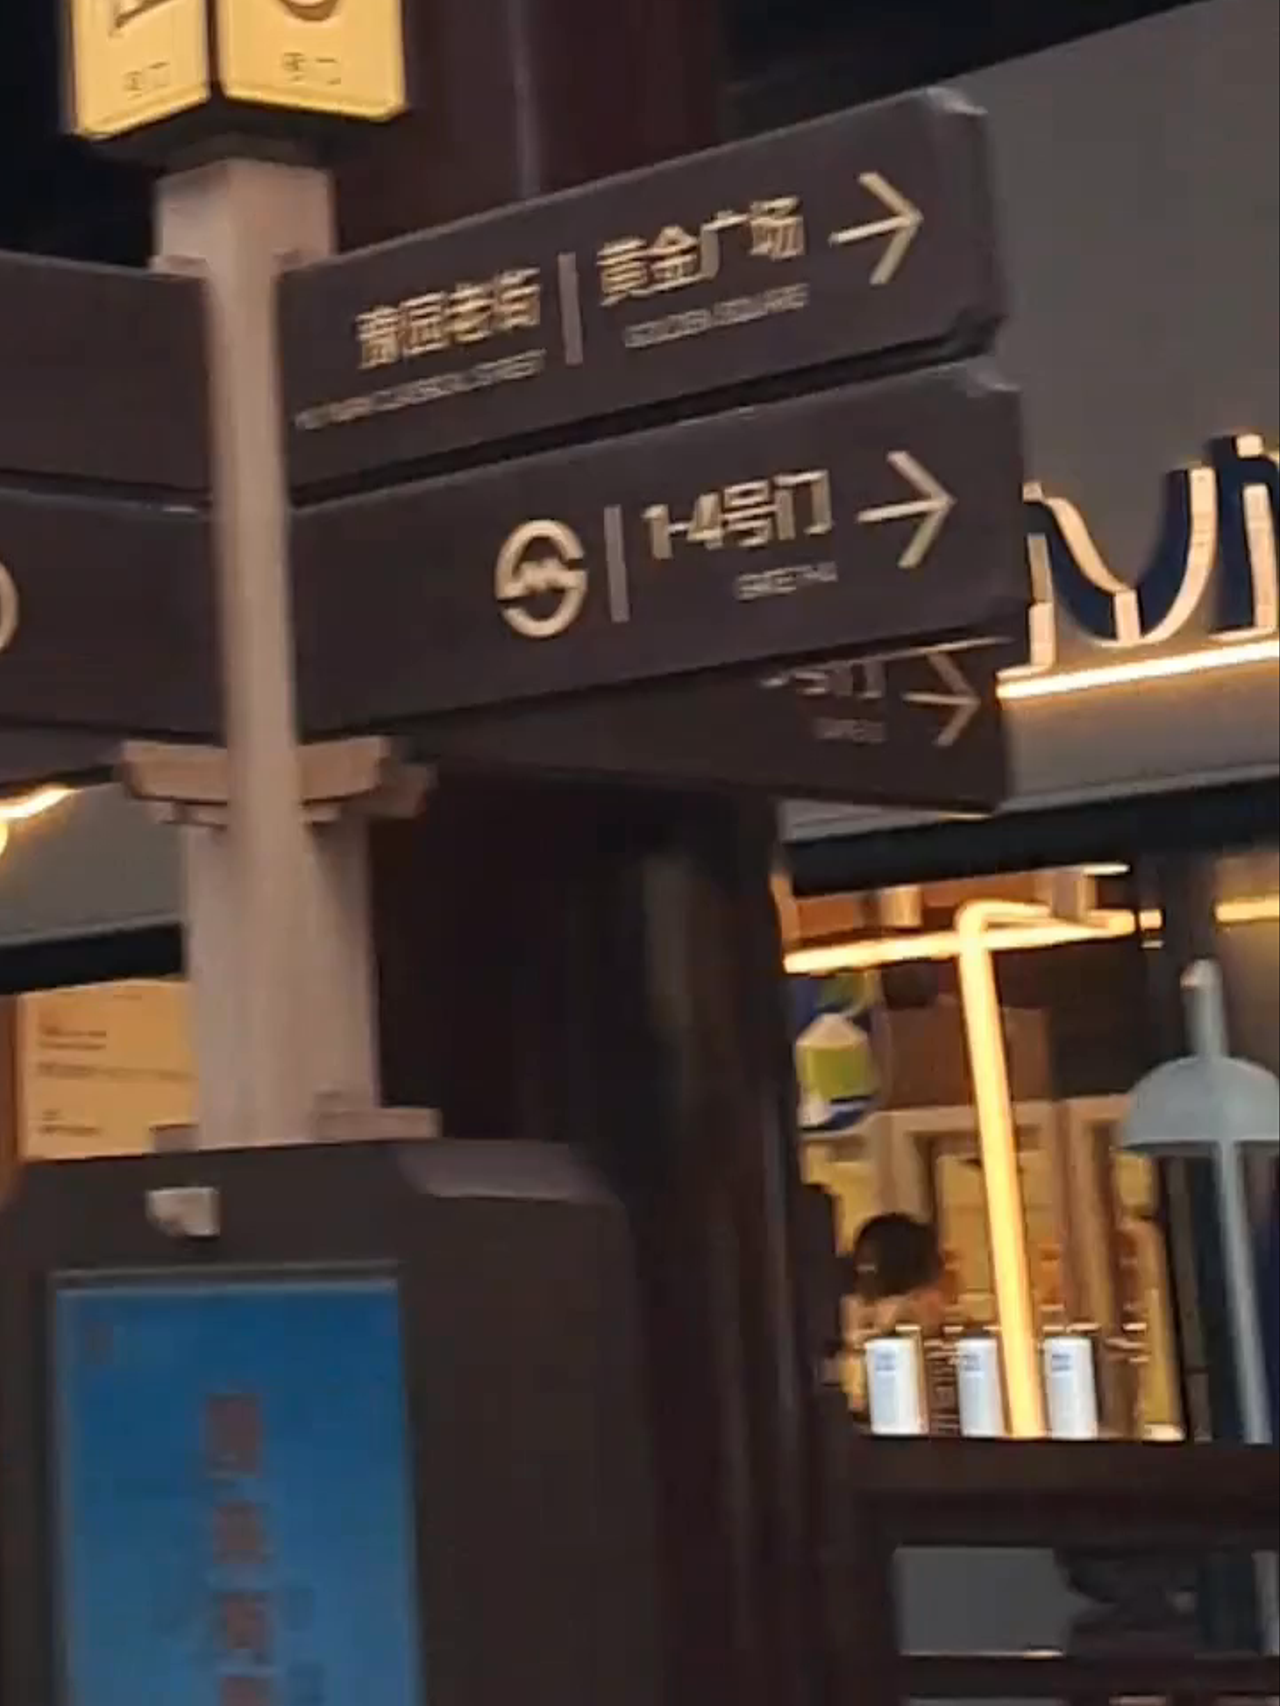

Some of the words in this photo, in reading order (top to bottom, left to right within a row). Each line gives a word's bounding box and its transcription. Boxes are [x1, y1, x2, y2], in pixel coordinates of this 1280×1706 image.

[595, 195, 806, 308] 黄金广场
[642, 468, 833, 560] 1-4号门
